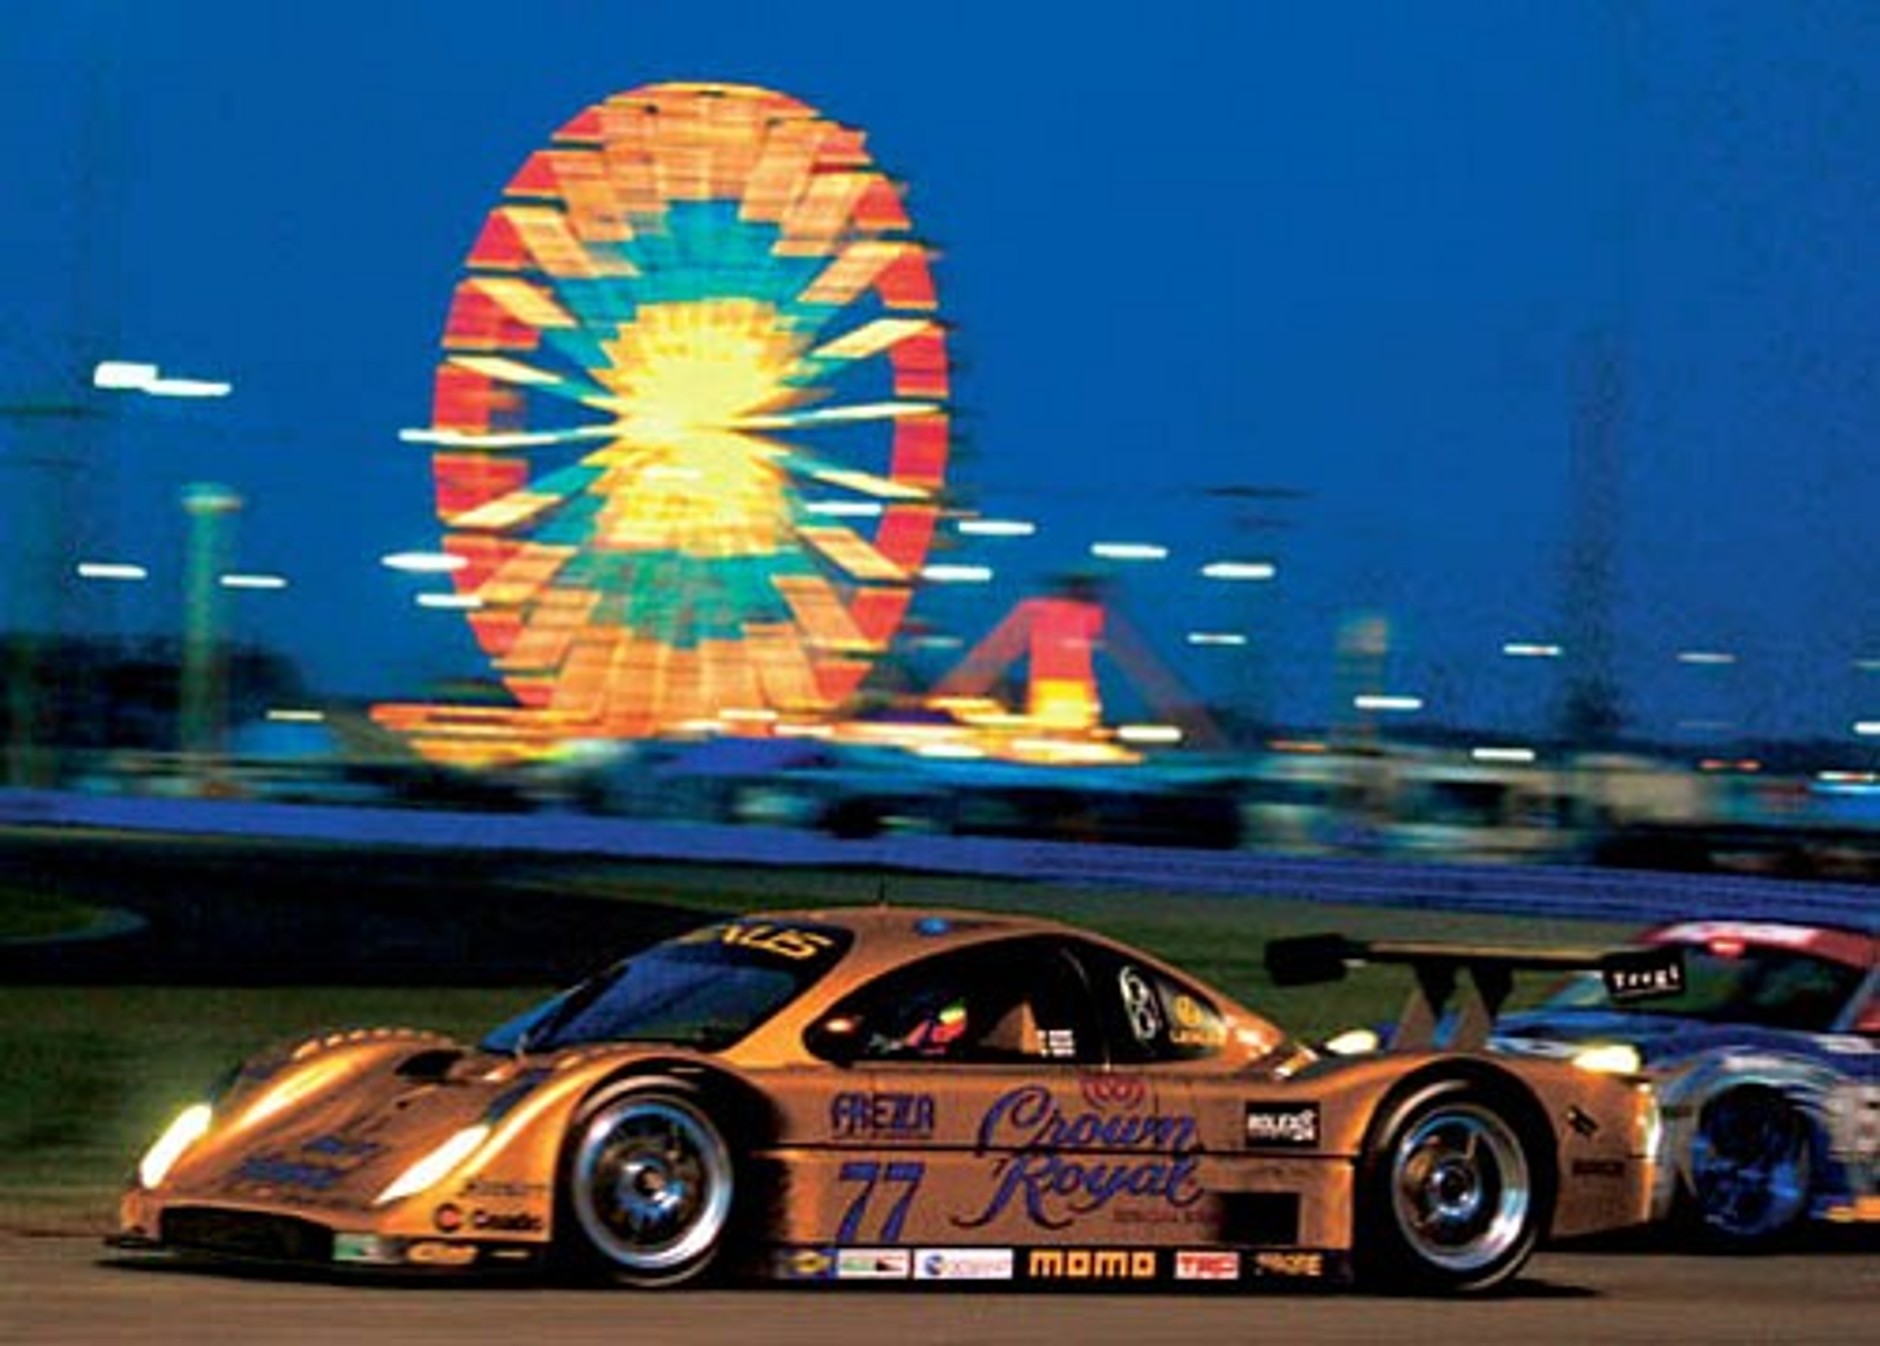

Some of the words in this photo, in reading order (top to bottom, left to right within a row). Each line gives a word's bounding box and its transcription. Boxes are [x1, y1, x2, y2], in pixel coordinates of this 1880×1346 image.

[976, 1084, 1205, 1157] Crown
[836, 1161, 926, 1244] 77
[950, 1150, 1206, 1229] Royal
[1029, 1249, 1156, 1278] MOMO
